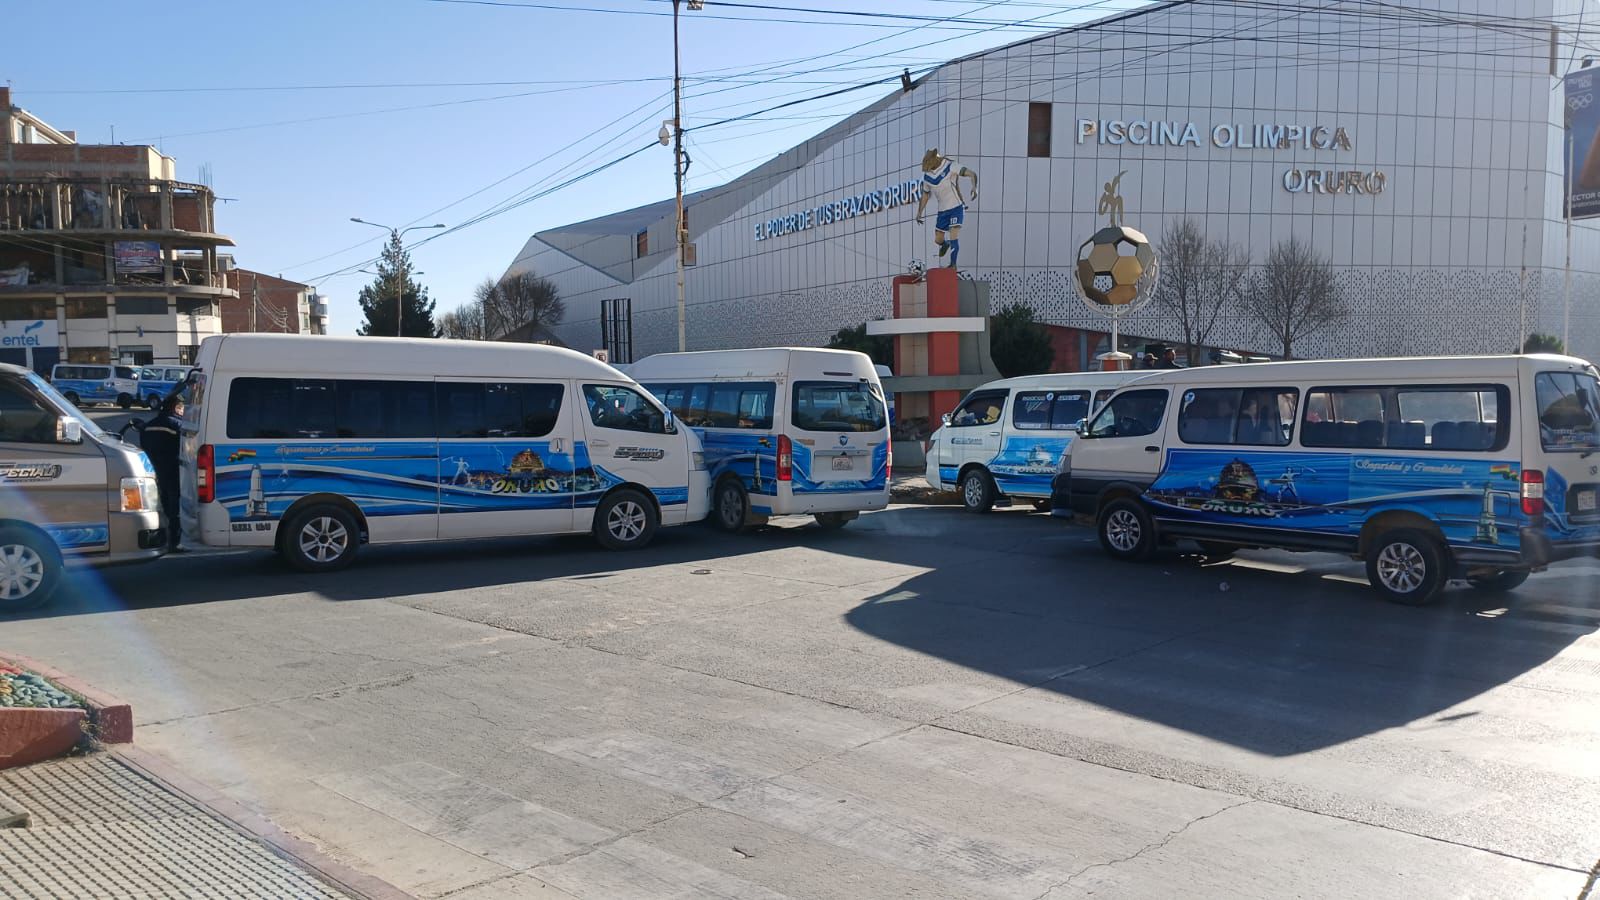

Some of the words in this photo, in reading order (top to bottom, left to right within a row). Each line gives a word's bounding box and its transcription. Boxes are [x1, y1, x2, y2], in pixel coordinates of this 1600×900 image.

[1078, 119, 1201, 147] PISCINA
[1212, 124, 1352, 151] OLIMPICA
[1283, 169, 1388, 194] ORURO
[754, 223, 766, 241] EL
[767, 215, 797, 238] PODER
[798, 210, 812, 231] DE
[813, 204, 832, 227] TUS
[834, 191, 881, 221] BRAZOS
[2, 334, 40, 346] entel
